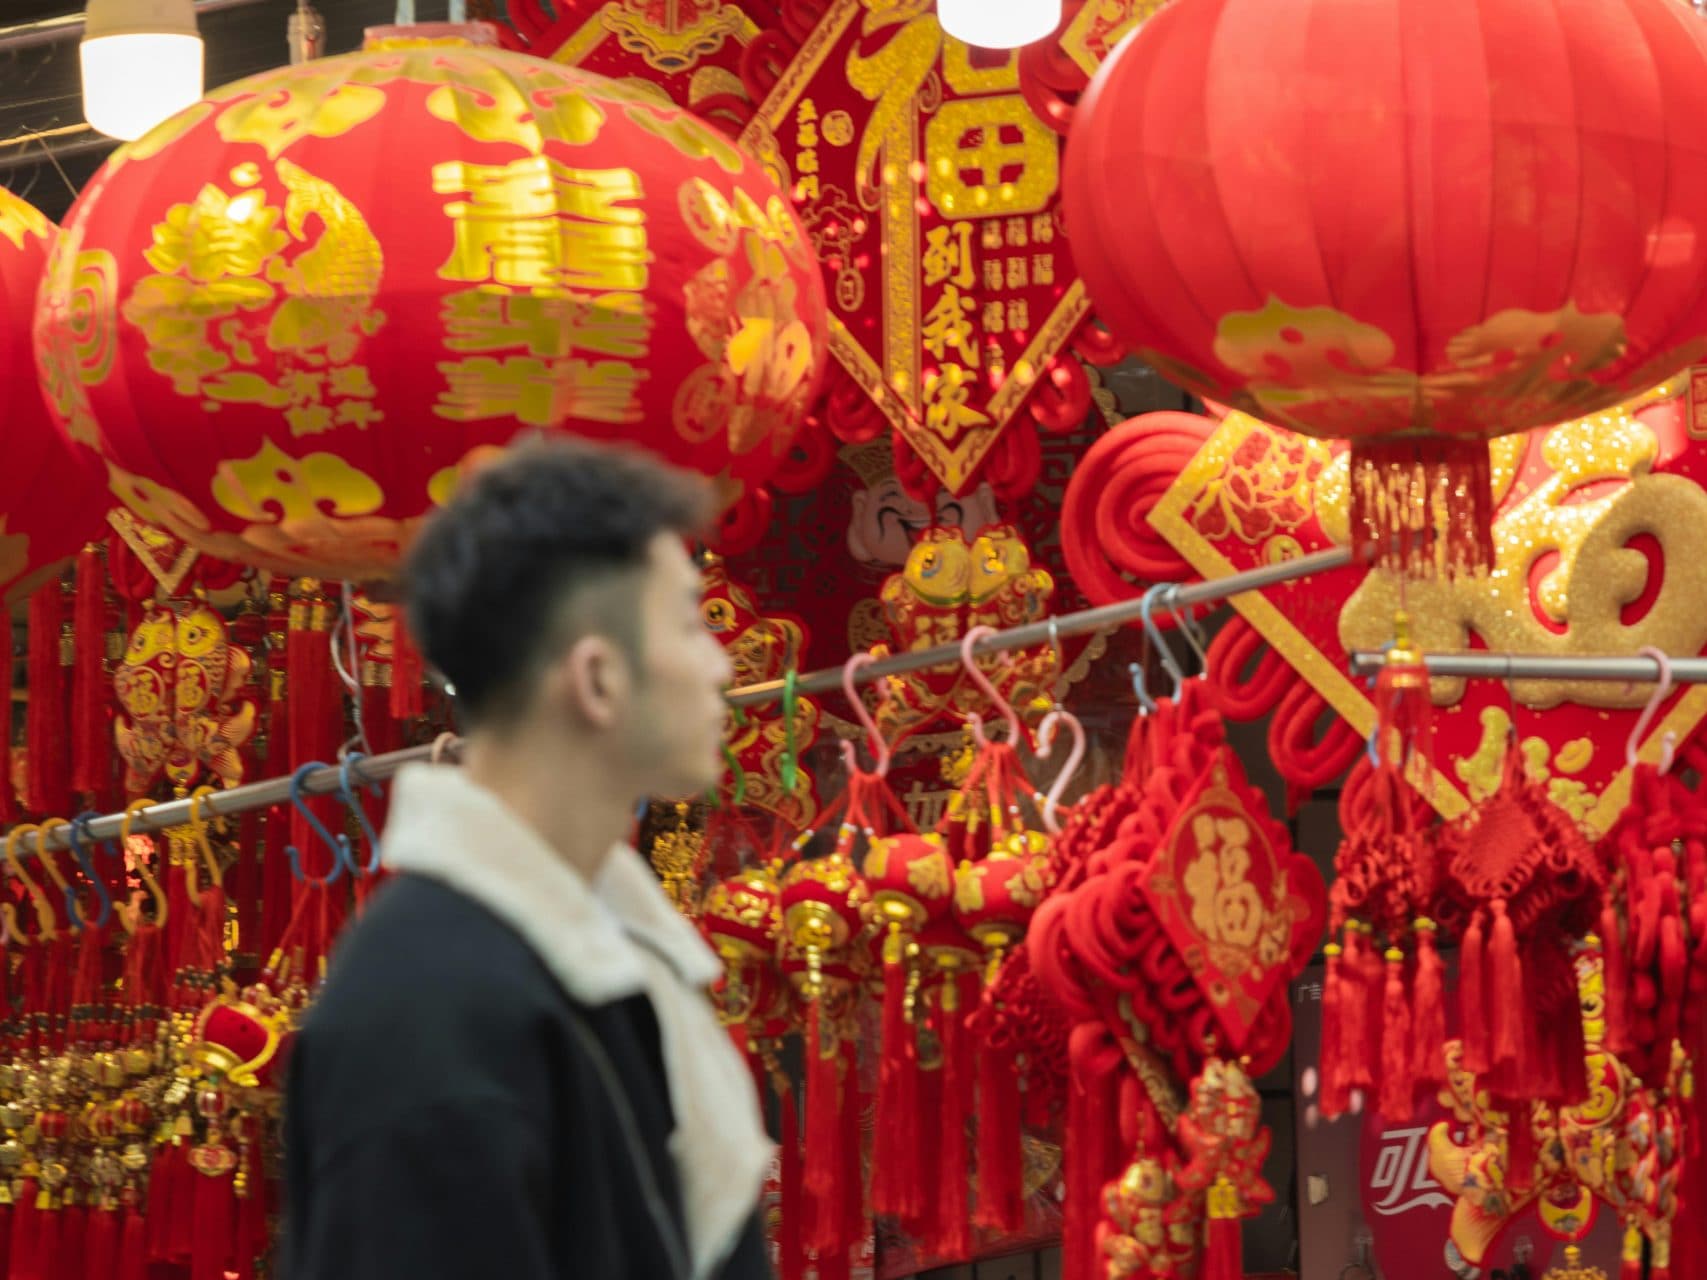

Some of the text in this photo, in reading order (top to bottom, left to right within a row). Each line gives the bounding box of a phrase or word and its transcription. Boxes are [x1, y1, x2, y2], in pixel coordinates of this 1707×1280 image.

[922, 221, 990, 439] 到我家
[1184, 813, 1262, 947] 福
